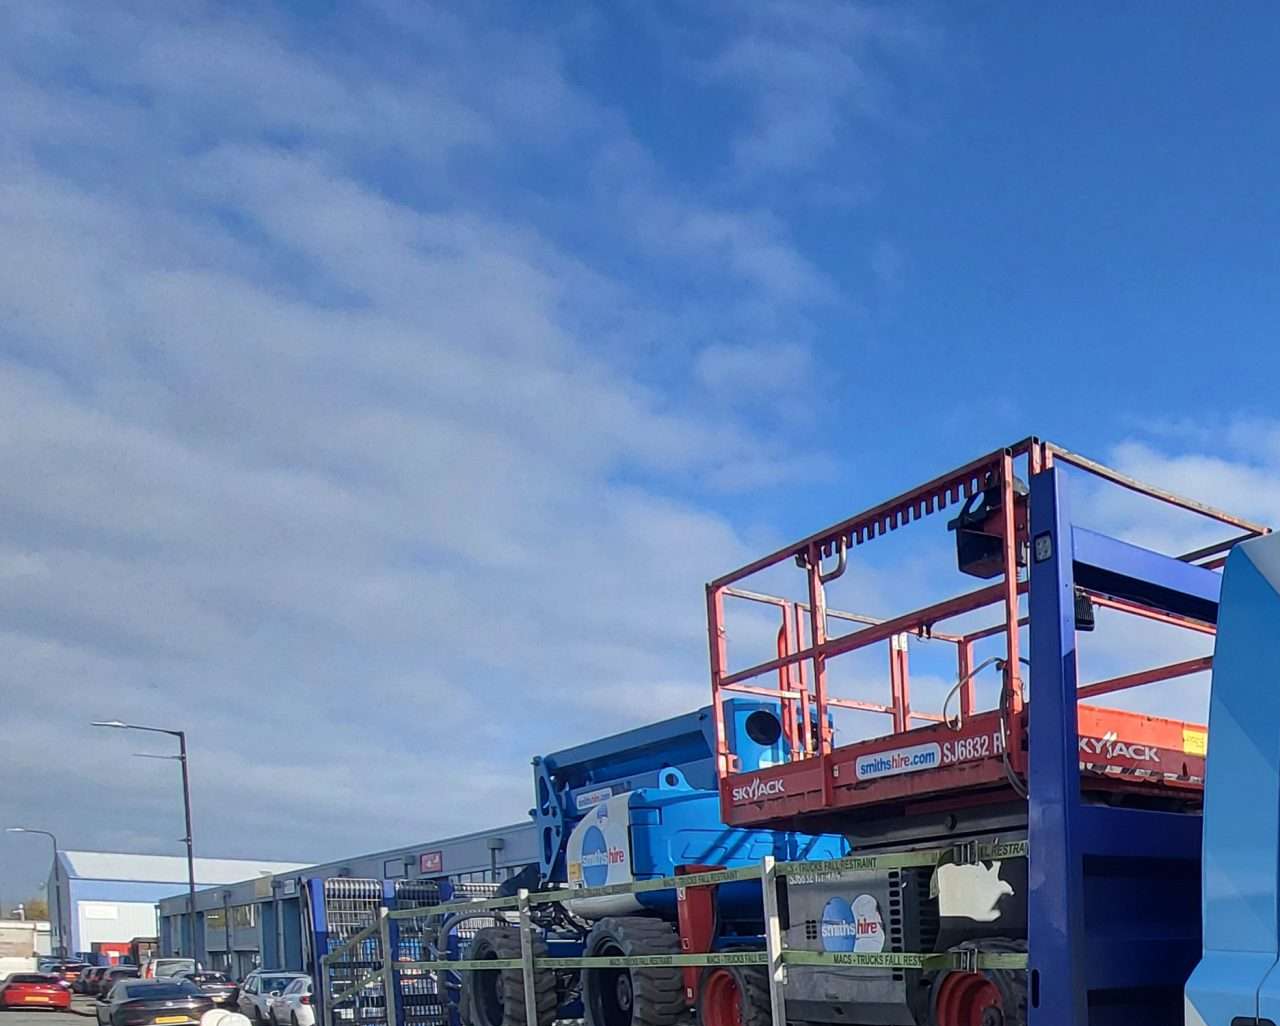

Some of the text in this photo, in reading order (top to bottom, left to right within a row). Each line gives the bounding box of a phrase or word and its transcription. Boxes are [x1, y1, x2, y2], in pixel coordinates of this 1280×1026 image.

[942, 739, 989, 764] SJ6832
[1078, 731, 1160, 762] KYJACK
[860, 751, 936, 776] smithshire.com
[732, 776, 785, 801] SKYJACK
[608, 846, 625, 864] hire
[821, 918, 878, 937] smiths hire
[833, 954, 852, 965] MACS
[857, 954, 884, 966] TRUCKS
[885, 955, 901, 965] FALL
